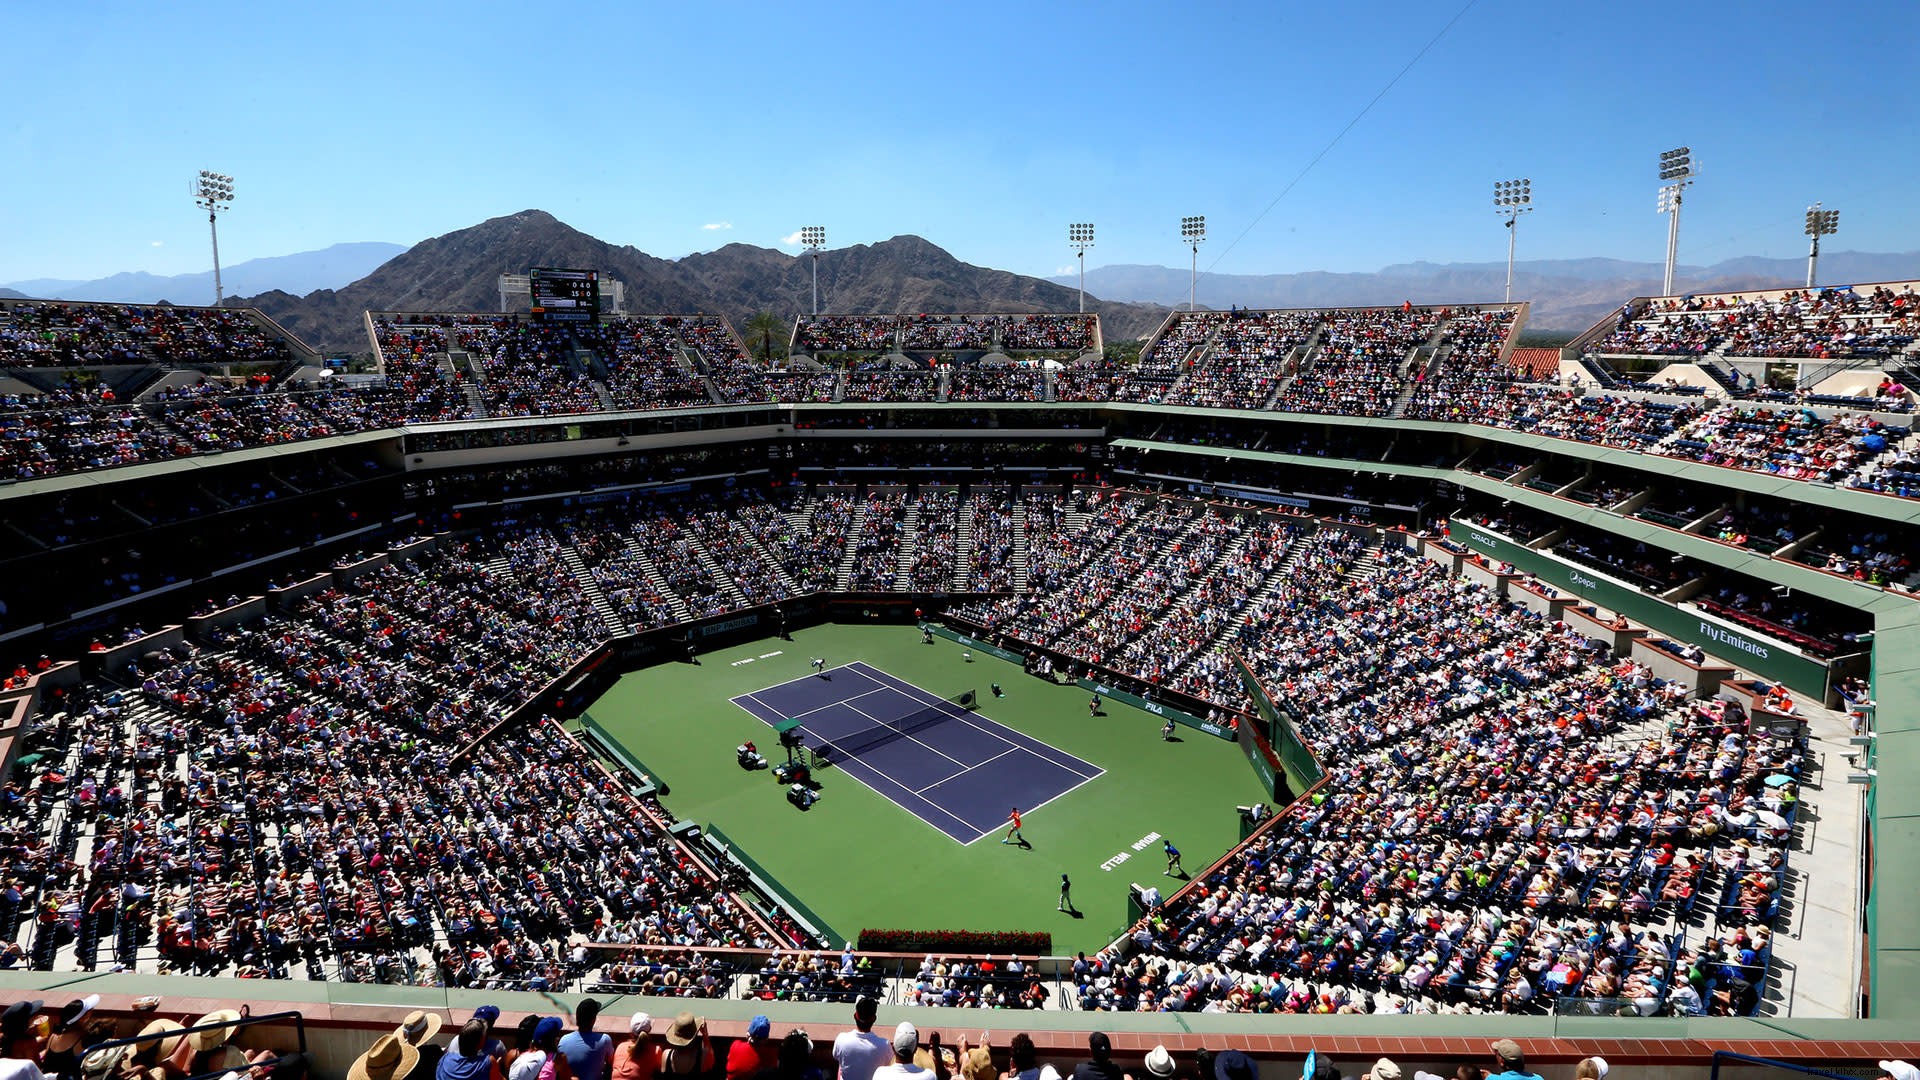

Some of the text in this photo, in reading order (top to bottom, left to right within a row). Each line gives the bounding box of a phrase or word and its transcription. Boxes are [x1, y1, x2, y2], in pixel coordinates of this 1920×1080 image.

[426, 488, 436, 496] 15
[1456, 493, 1465, 501] 15
[1350, 505, 1371, 513] ATP
[1471, 532, 1497, 548] ORACLE
[1578, 576, 1596, 590] pepsi
[1700, 622, 1769, 659] Fly Emirates
[1145, 702, 1163, 714] FILA
